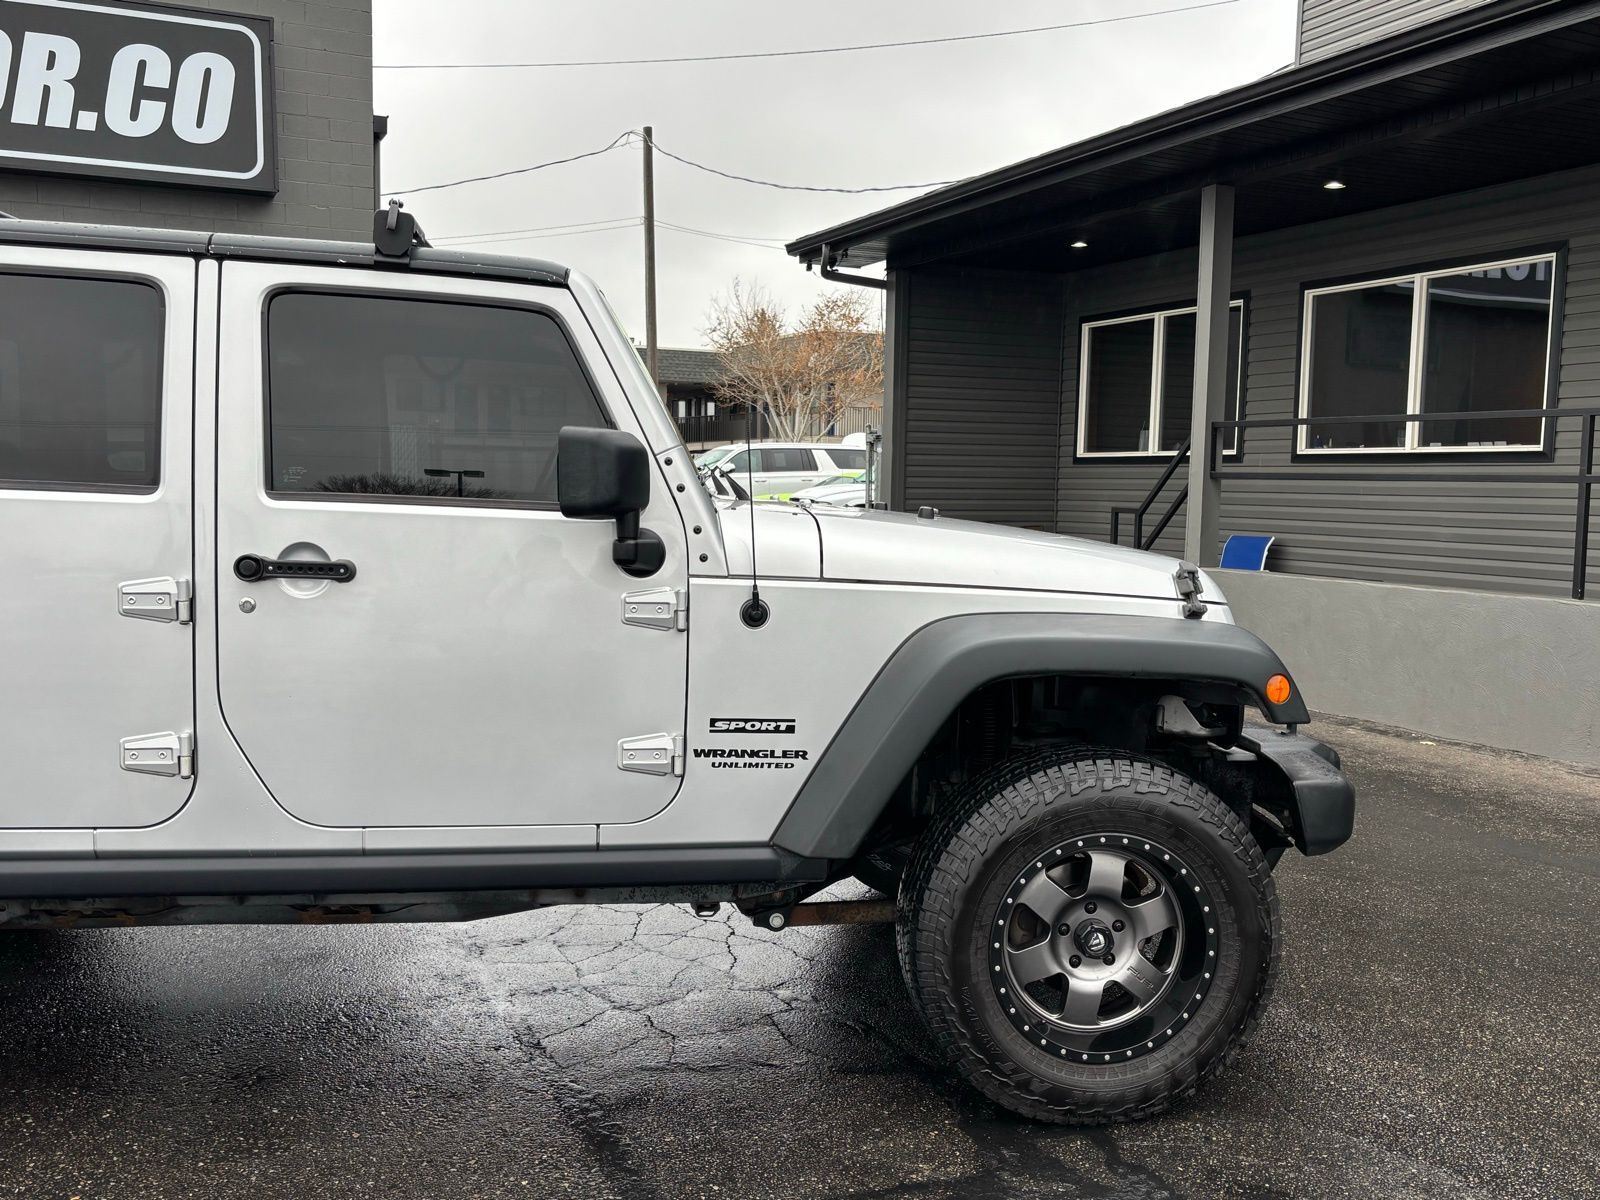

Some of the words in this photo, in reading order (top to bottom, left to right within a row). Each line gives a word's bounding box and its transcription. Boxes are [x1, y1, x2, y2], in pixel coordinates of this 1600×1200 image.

[0, 29, 236, 144] R.CO
[710, 720, 796, 732] SPORT
[693, 748, 808, 760] WRANGLER
